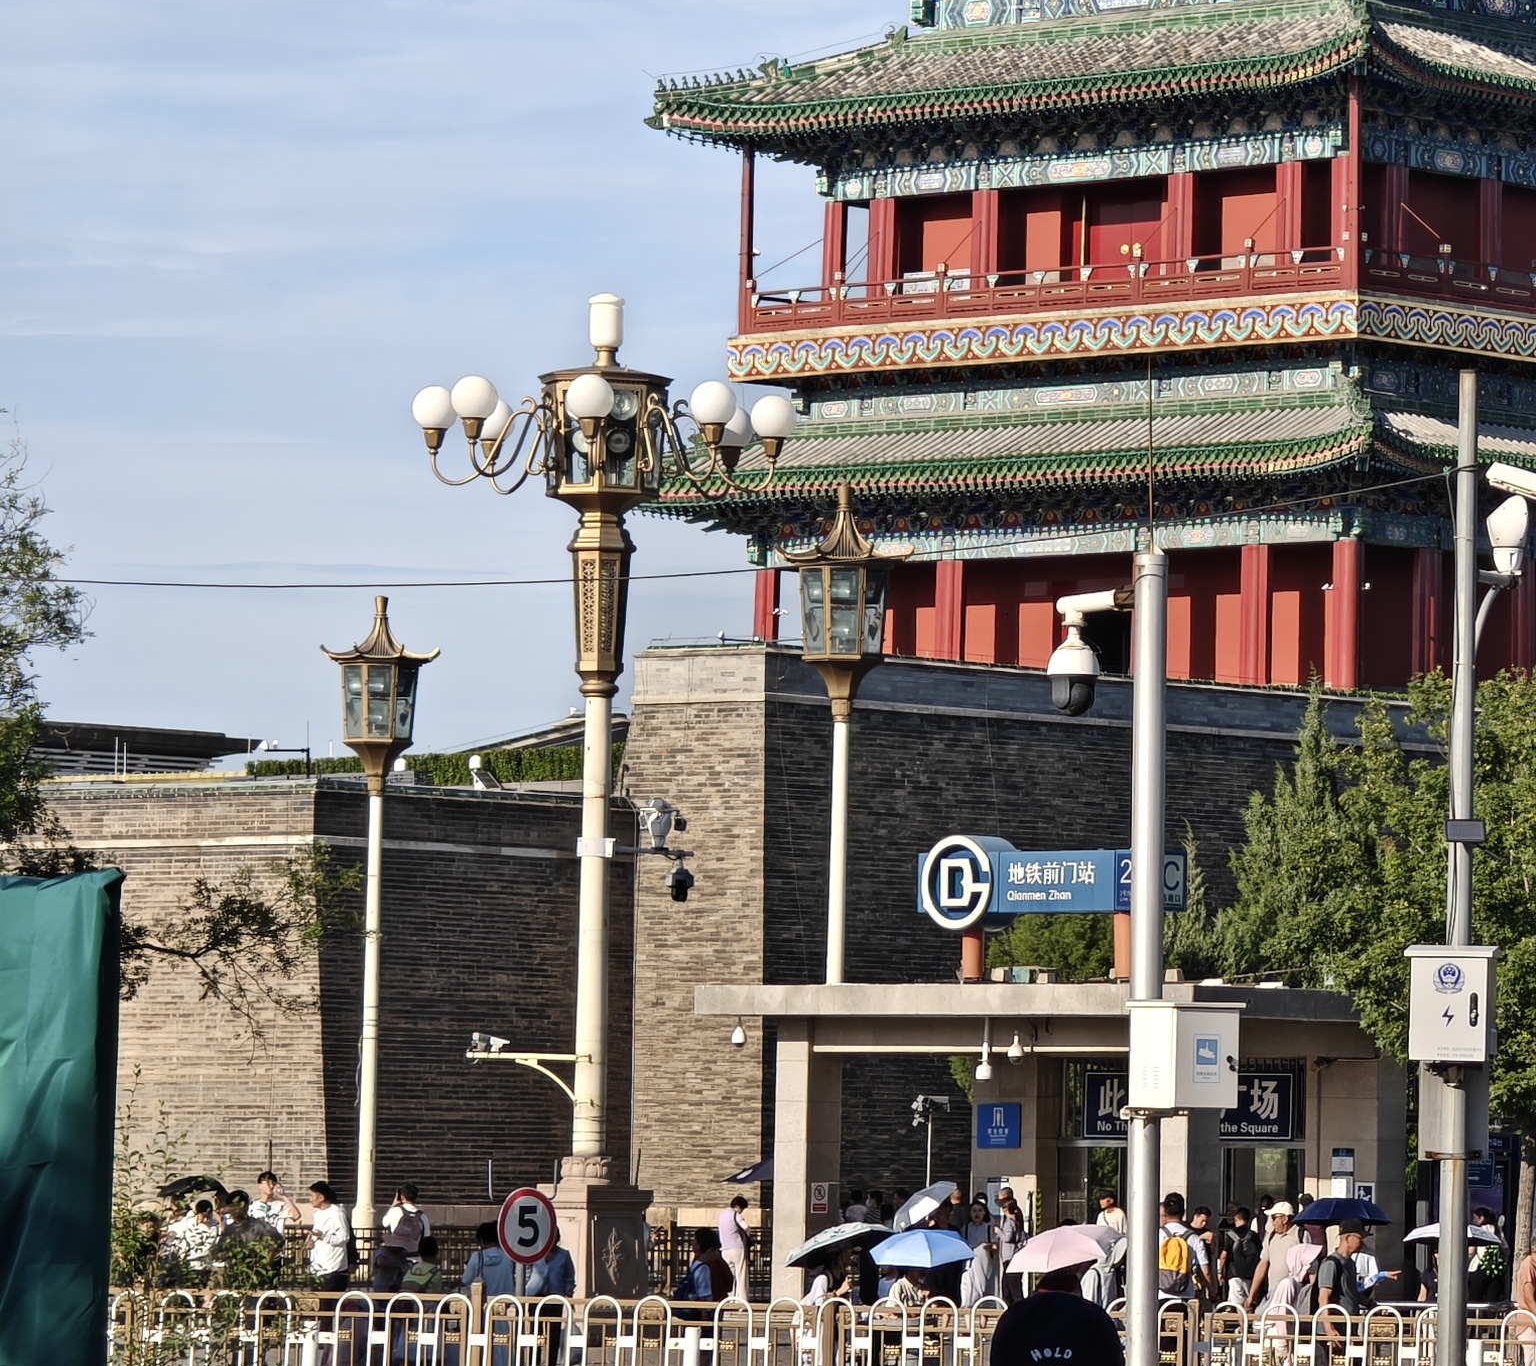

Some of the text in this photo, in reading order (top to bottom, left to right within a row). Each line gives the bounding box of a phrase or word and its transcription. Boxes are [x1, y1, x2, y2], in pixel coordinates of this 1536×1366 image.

[1007, 861, 1096, 885] 地铁前门站
[1119, 858, 1132, 884] 2
[1163, 861, 1180, 891] C
[1007, 890, 1072, 901] Qianmen Zhan
[1097, 1121, 1112, 1132] No
[1220, 1122, 1238, 1133] the
[1240, 1122, 1279, 1134] Square
[517, 1205, 540, 1248] 5
